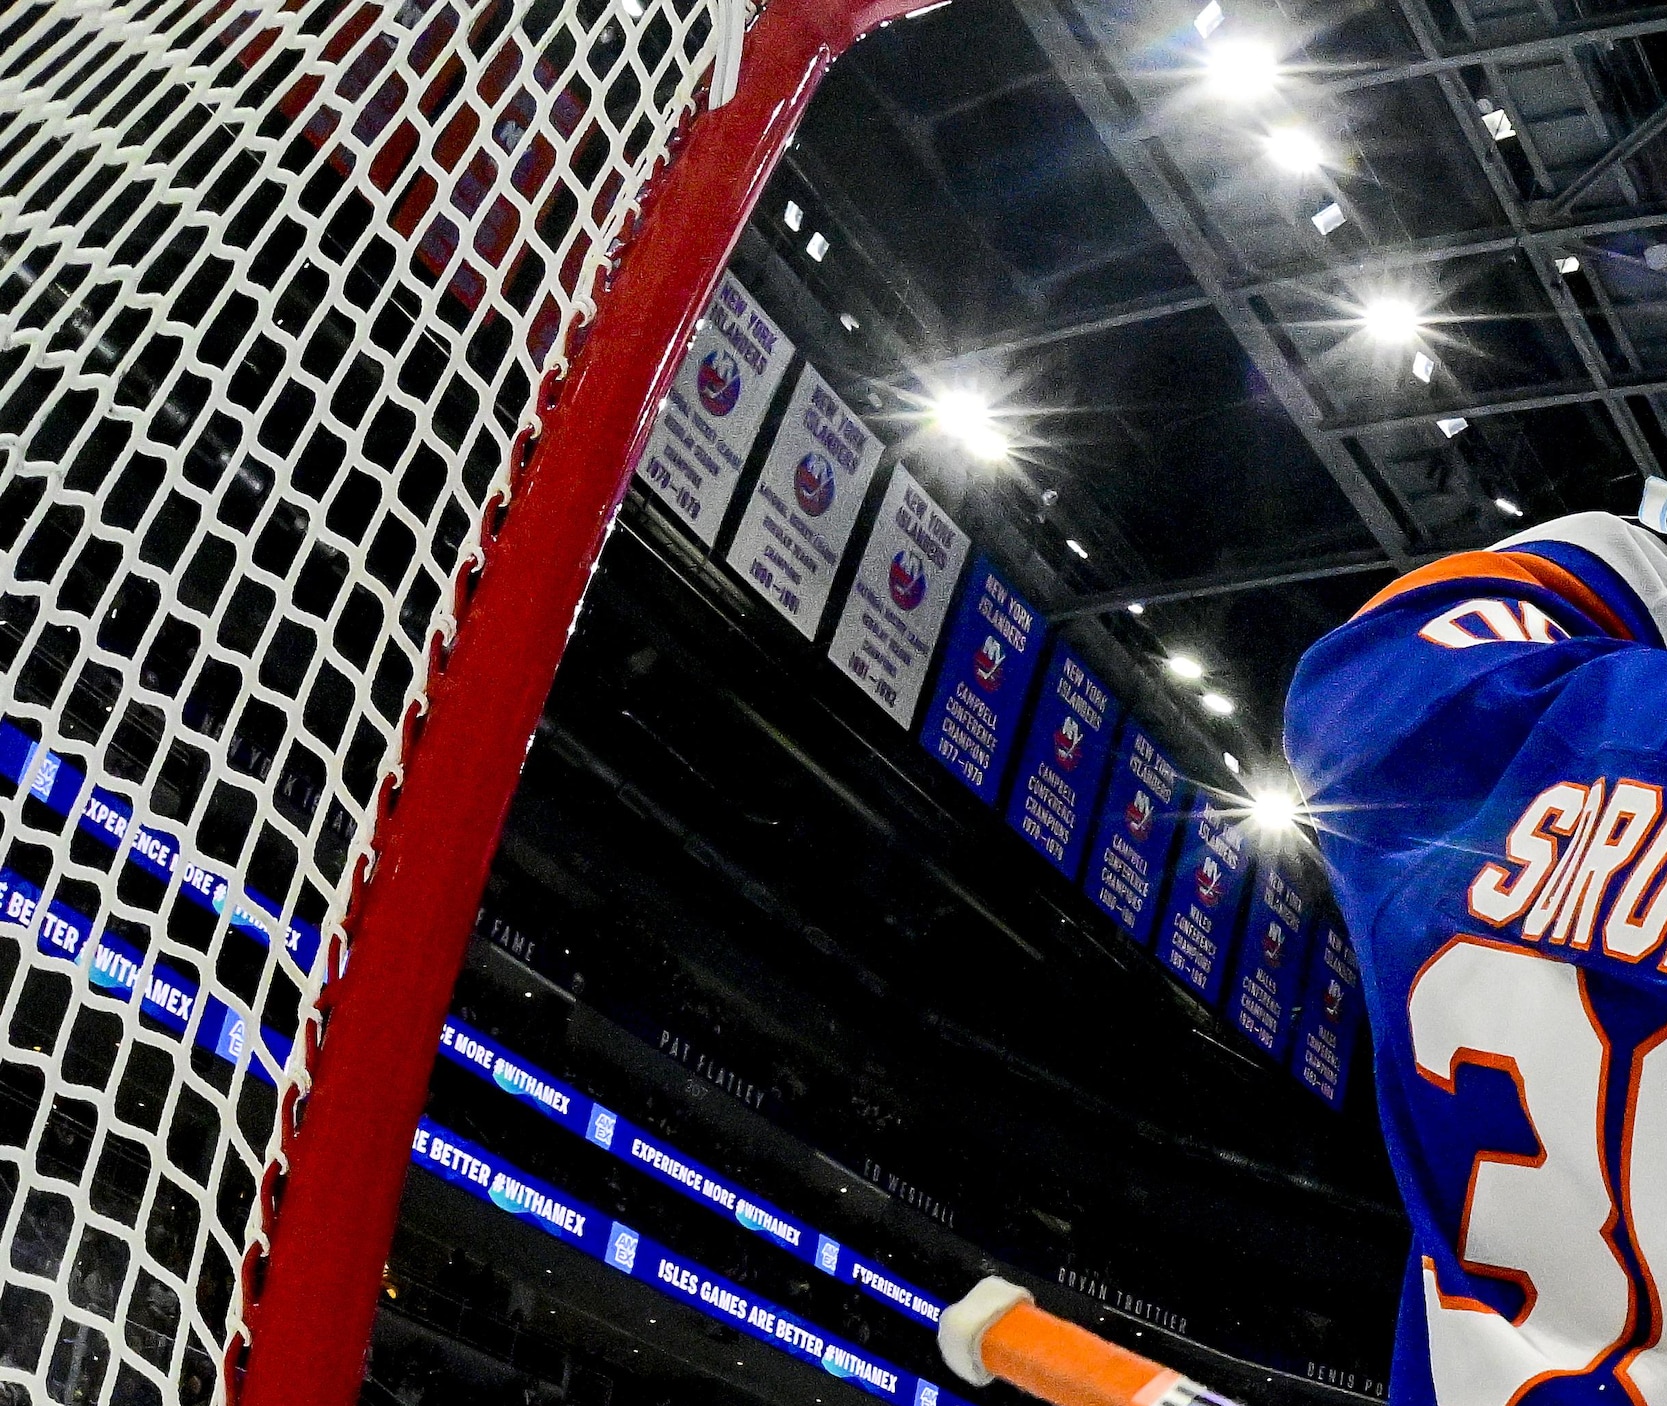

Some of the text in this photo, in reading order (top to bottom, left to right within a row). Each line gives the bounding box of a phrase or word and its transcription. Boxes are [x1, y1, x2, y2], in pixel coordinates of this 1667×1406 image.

[454, 1033, 495, 1070] MORE
[493, 1057, 570, 1115] #WITHAMEX
[631, 1138, 801, 1246] EXPERIENCE MORE #WITHAMEX
[658, 1258, 898, 1394] ISLES GAMES ARE BETTER #WITHAMEX
